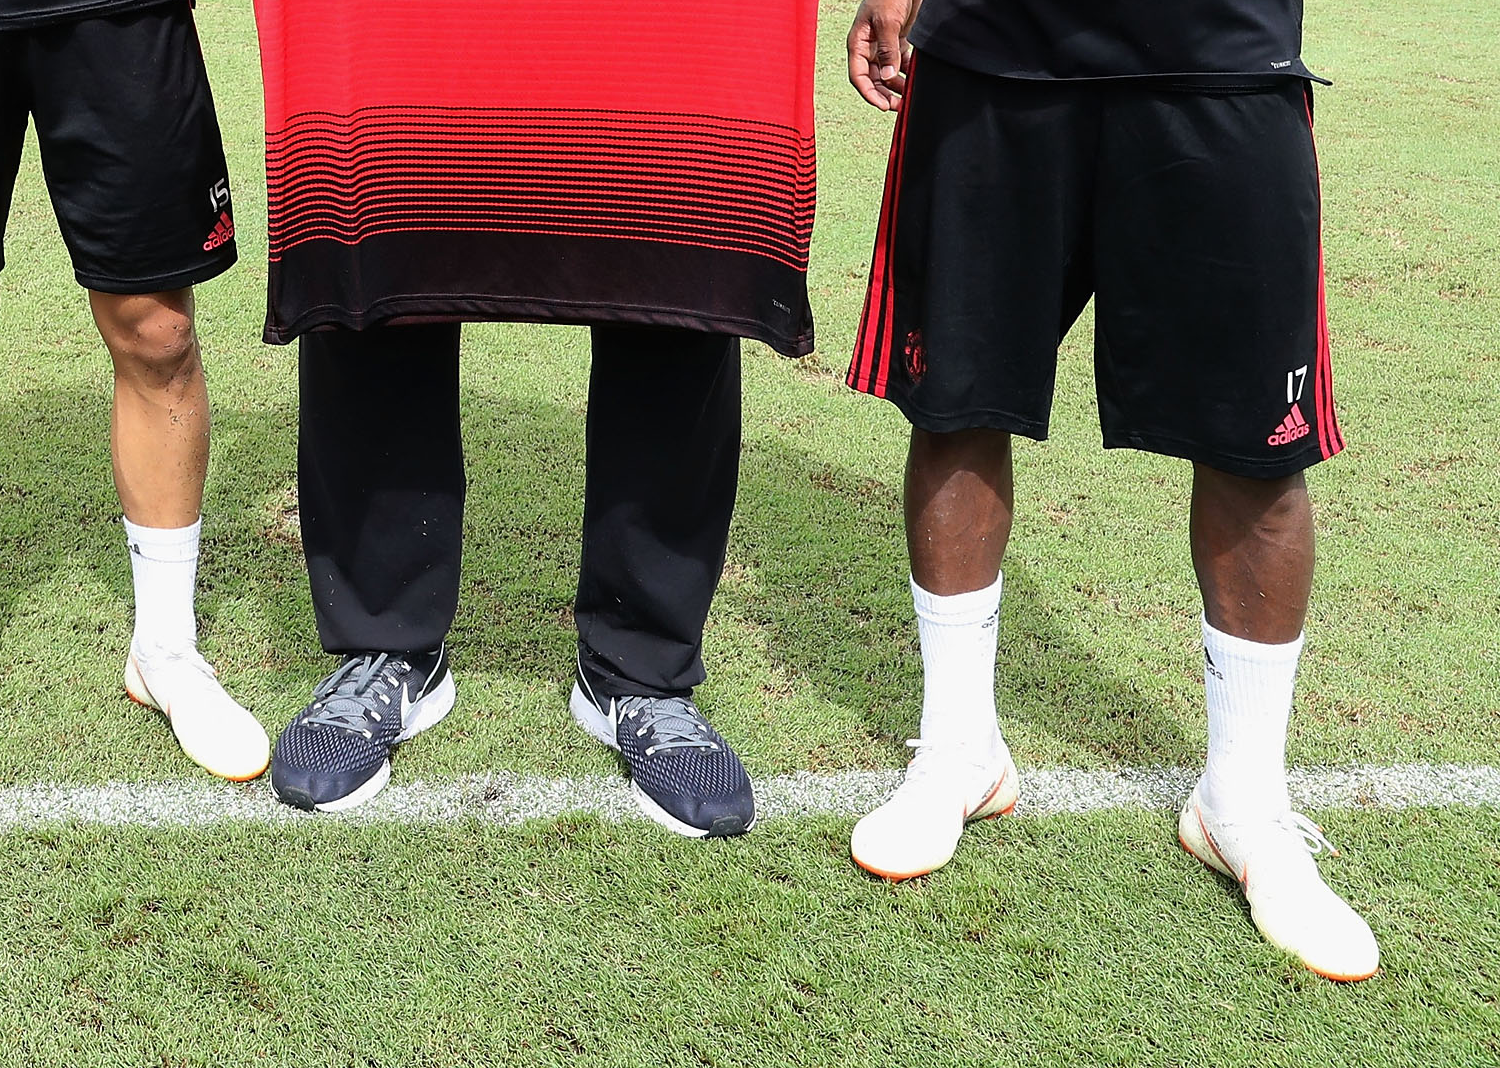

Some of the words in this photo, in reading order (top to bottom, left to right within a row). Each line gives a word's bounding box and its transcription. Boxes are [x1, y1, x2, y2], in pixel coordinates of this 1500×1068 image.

[209, 177, 229, 212] 15
[203, 226, 234, 251] adida
[1286, 364, 1308, 404] 17
[1267, 423, 1310, 446] adidas
